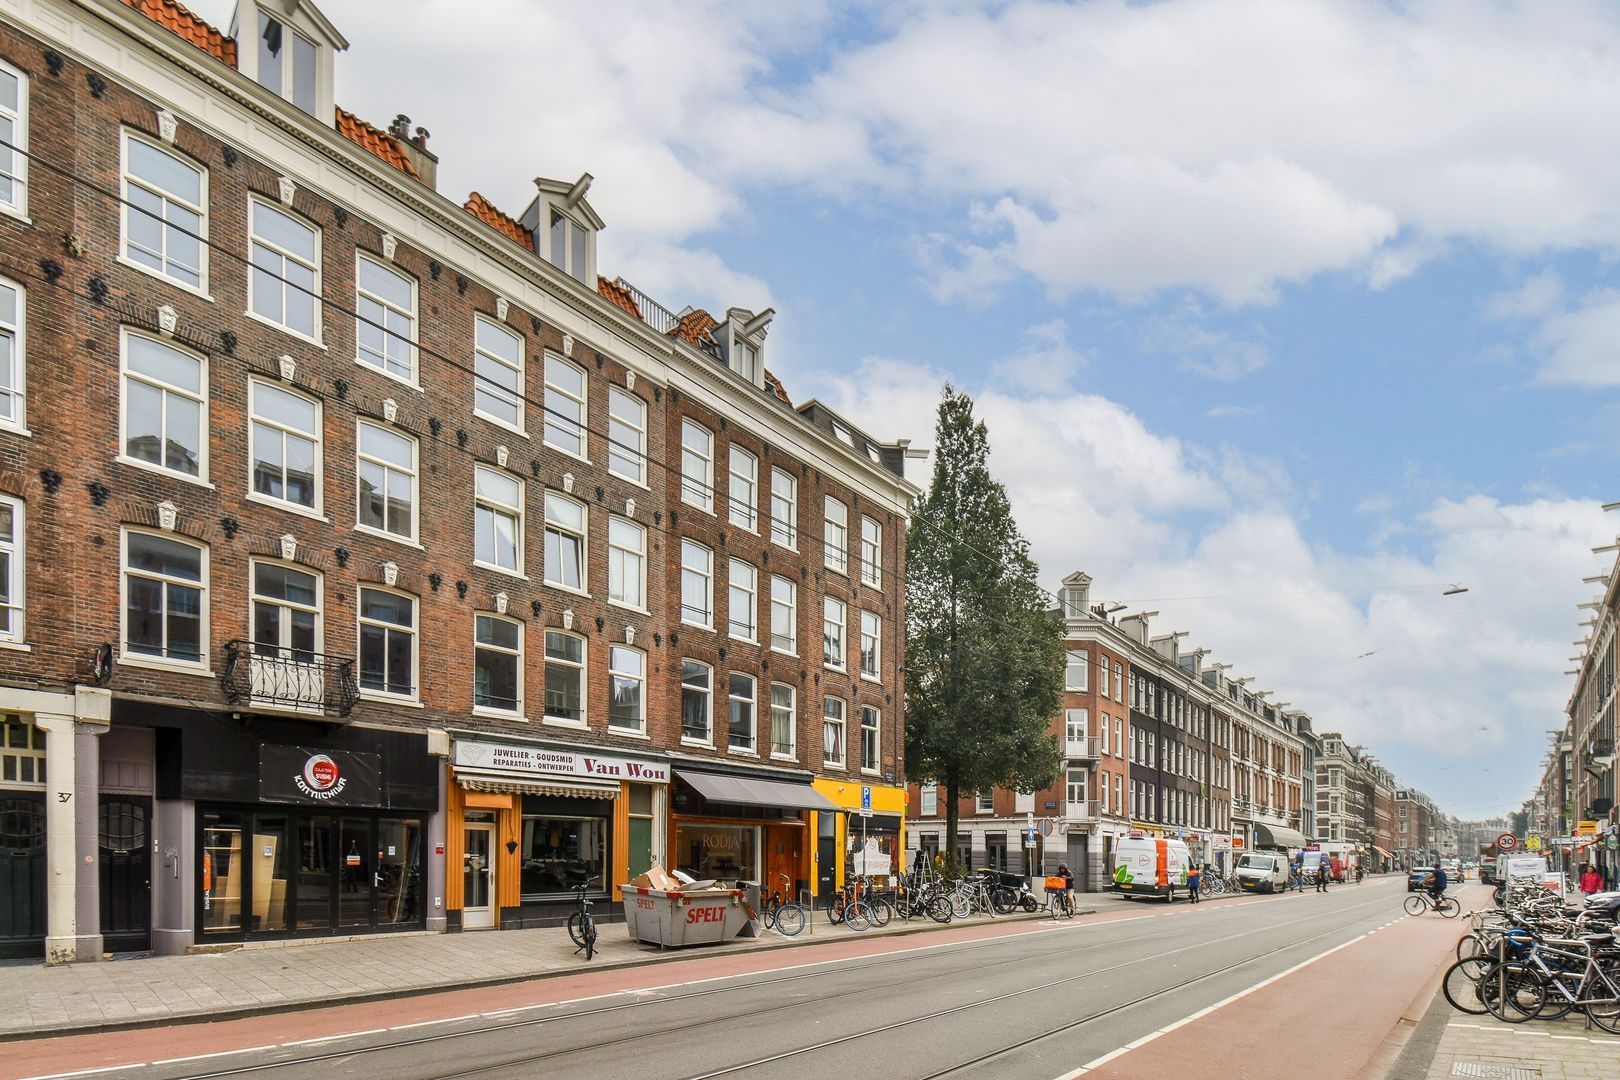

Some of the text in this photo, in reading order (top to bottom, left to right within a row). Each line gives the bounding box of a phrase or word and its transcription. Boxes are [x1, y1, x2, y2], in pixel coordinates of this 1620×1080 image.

[493, 748, 530, 759] JUWELIER
[536, 753, 573, 763] GOUDSMID
[493, 758, 532, 768] REPARATIES
[537, 762, 574, 772] ONTWERPEN
[583, 757, 621, 776] Van
[57, 792, 72, 803] 37
[863, 787, 870, 799] P
[1501, 837, 1514, 845] 30
[637, 898, 656, 910] SPELT
[686, 906, 726, 925] SPELT
